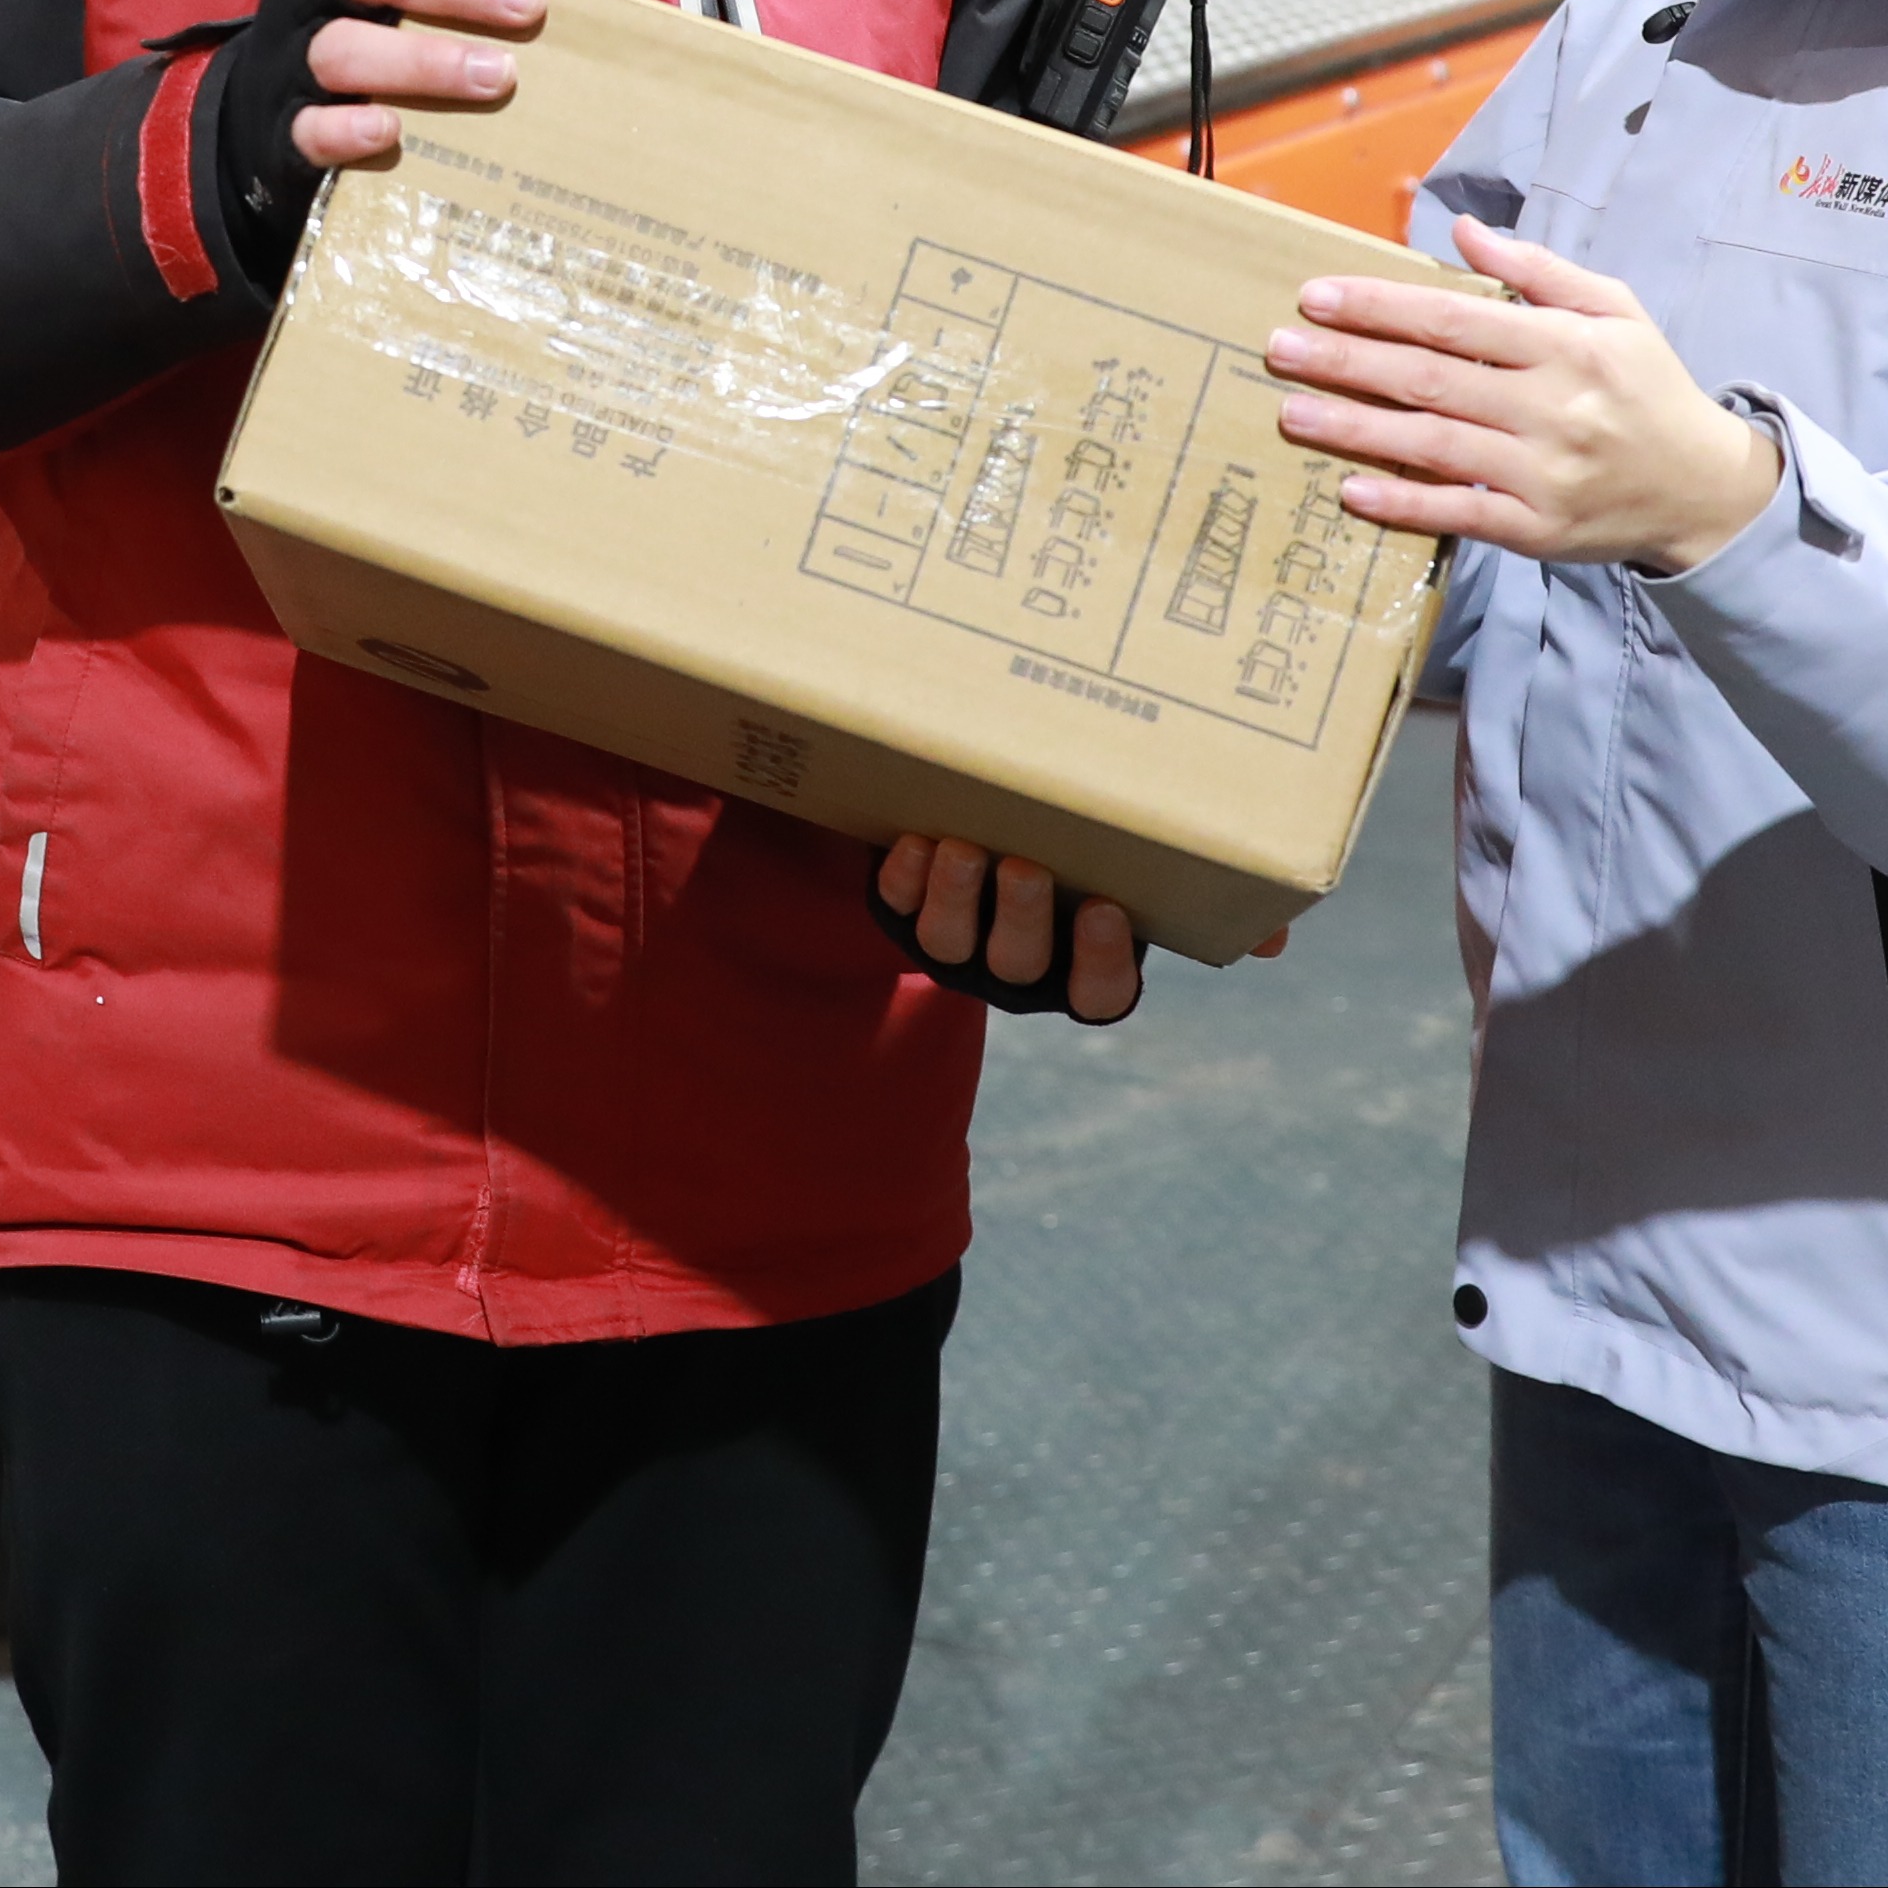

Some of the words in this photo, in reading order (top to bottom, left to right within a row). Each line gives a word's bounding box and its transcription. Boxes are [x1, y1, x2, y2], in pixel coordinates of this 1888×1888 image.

[399, 362, 669, 484] 产品合格证
